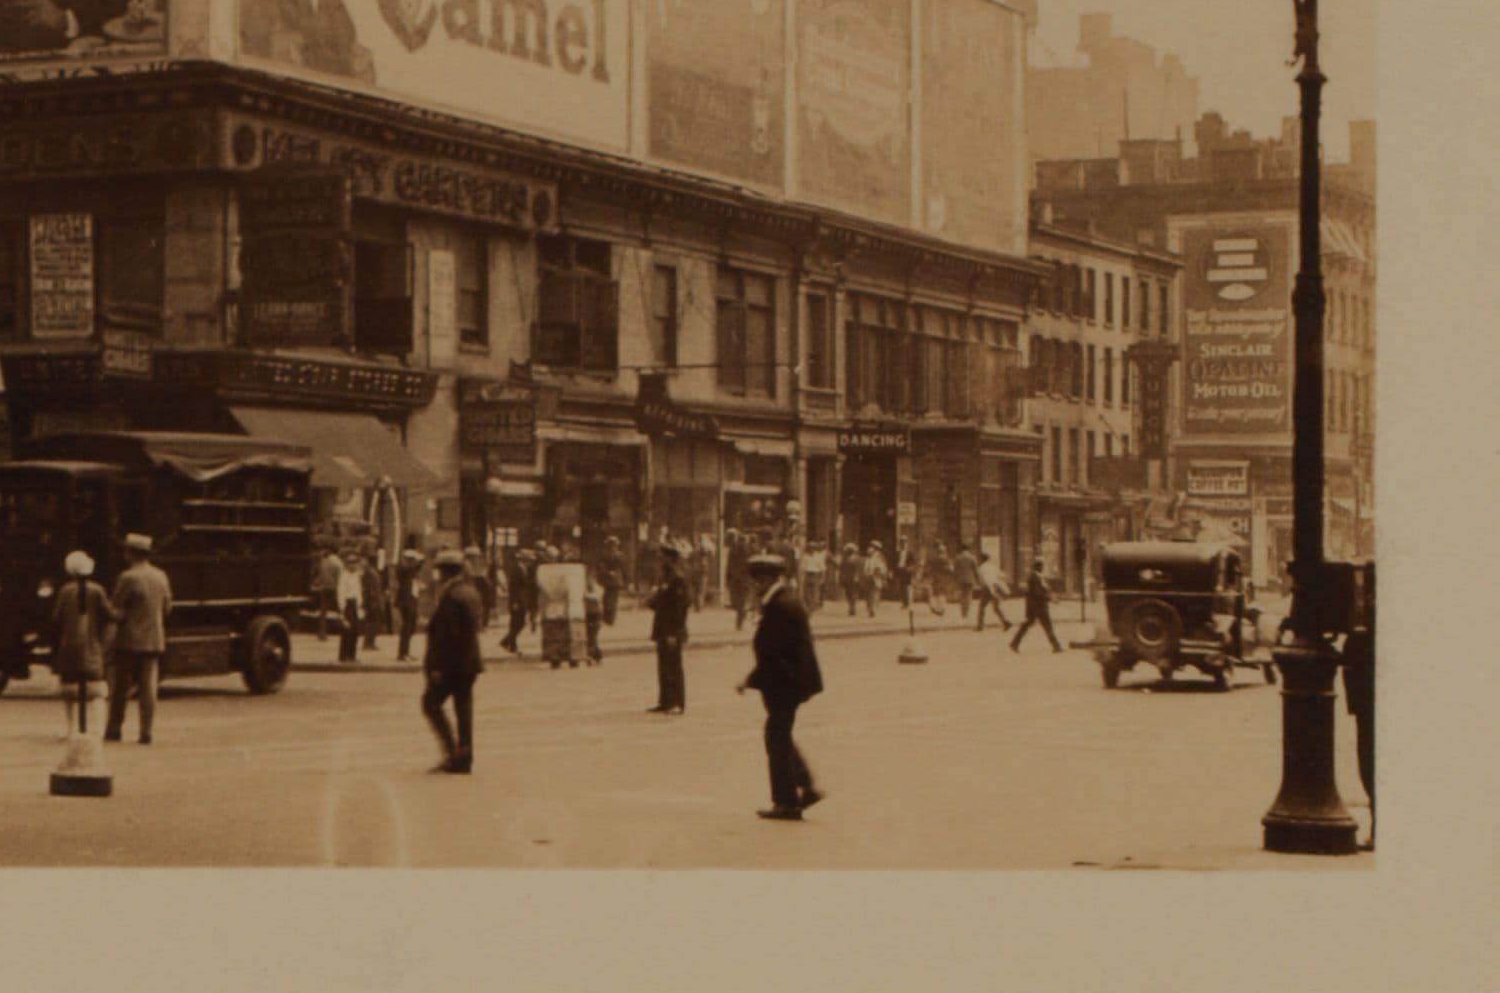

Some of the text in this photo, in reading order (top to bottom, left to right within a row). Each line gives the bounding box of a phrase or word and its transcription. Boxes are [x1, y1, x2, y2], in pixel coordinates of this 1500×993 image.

[1200, 342, 1275, 358] SINCLAIR
[1193, 381, 1282, 399] MOTOR OIL
[839, 433, 906, 448] DANCING
